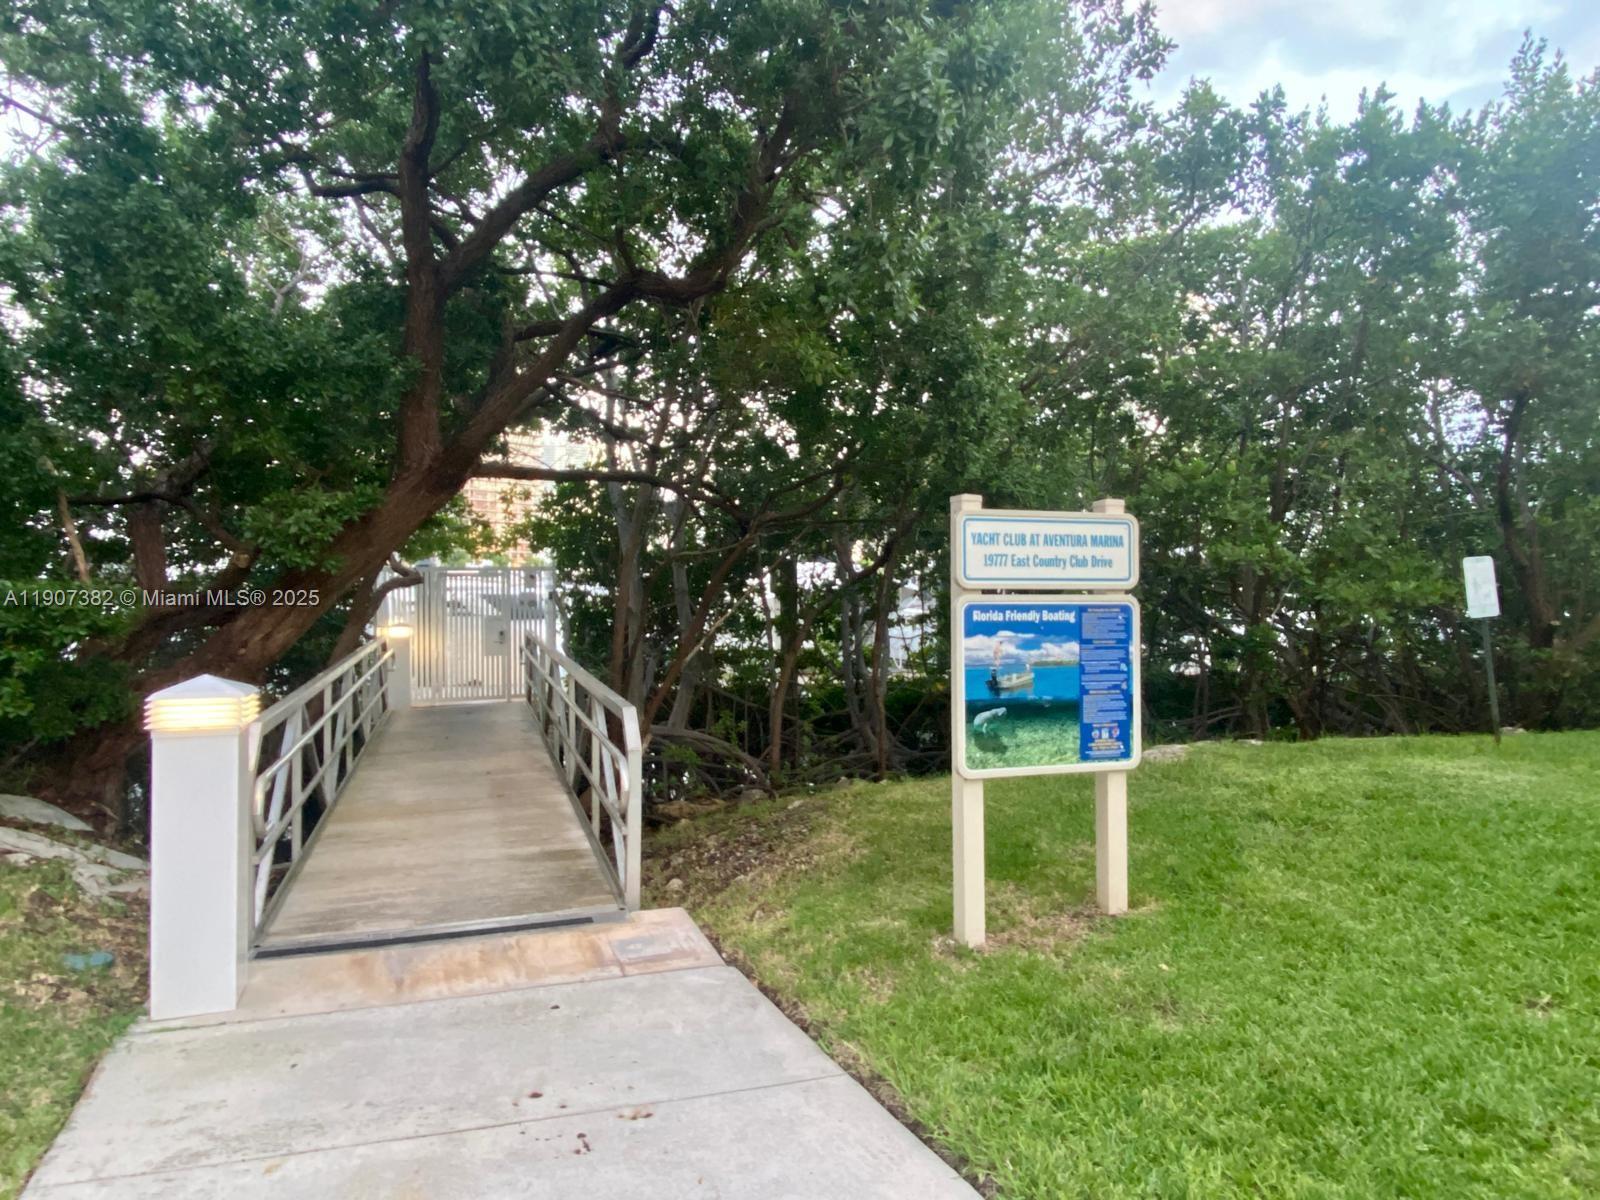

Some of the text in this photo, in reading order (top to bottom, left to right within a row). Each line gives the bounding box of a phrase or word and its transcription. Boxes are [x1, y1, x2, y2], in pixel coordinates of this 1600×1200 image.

[971, 532, 1124, 548] YACHT CLUB AT AVENTURA MARINA
[984, 554, 1113, 570] 19777 East Country Club Drive
[973, 610, 1076, 624] Florida Friendly Boating
